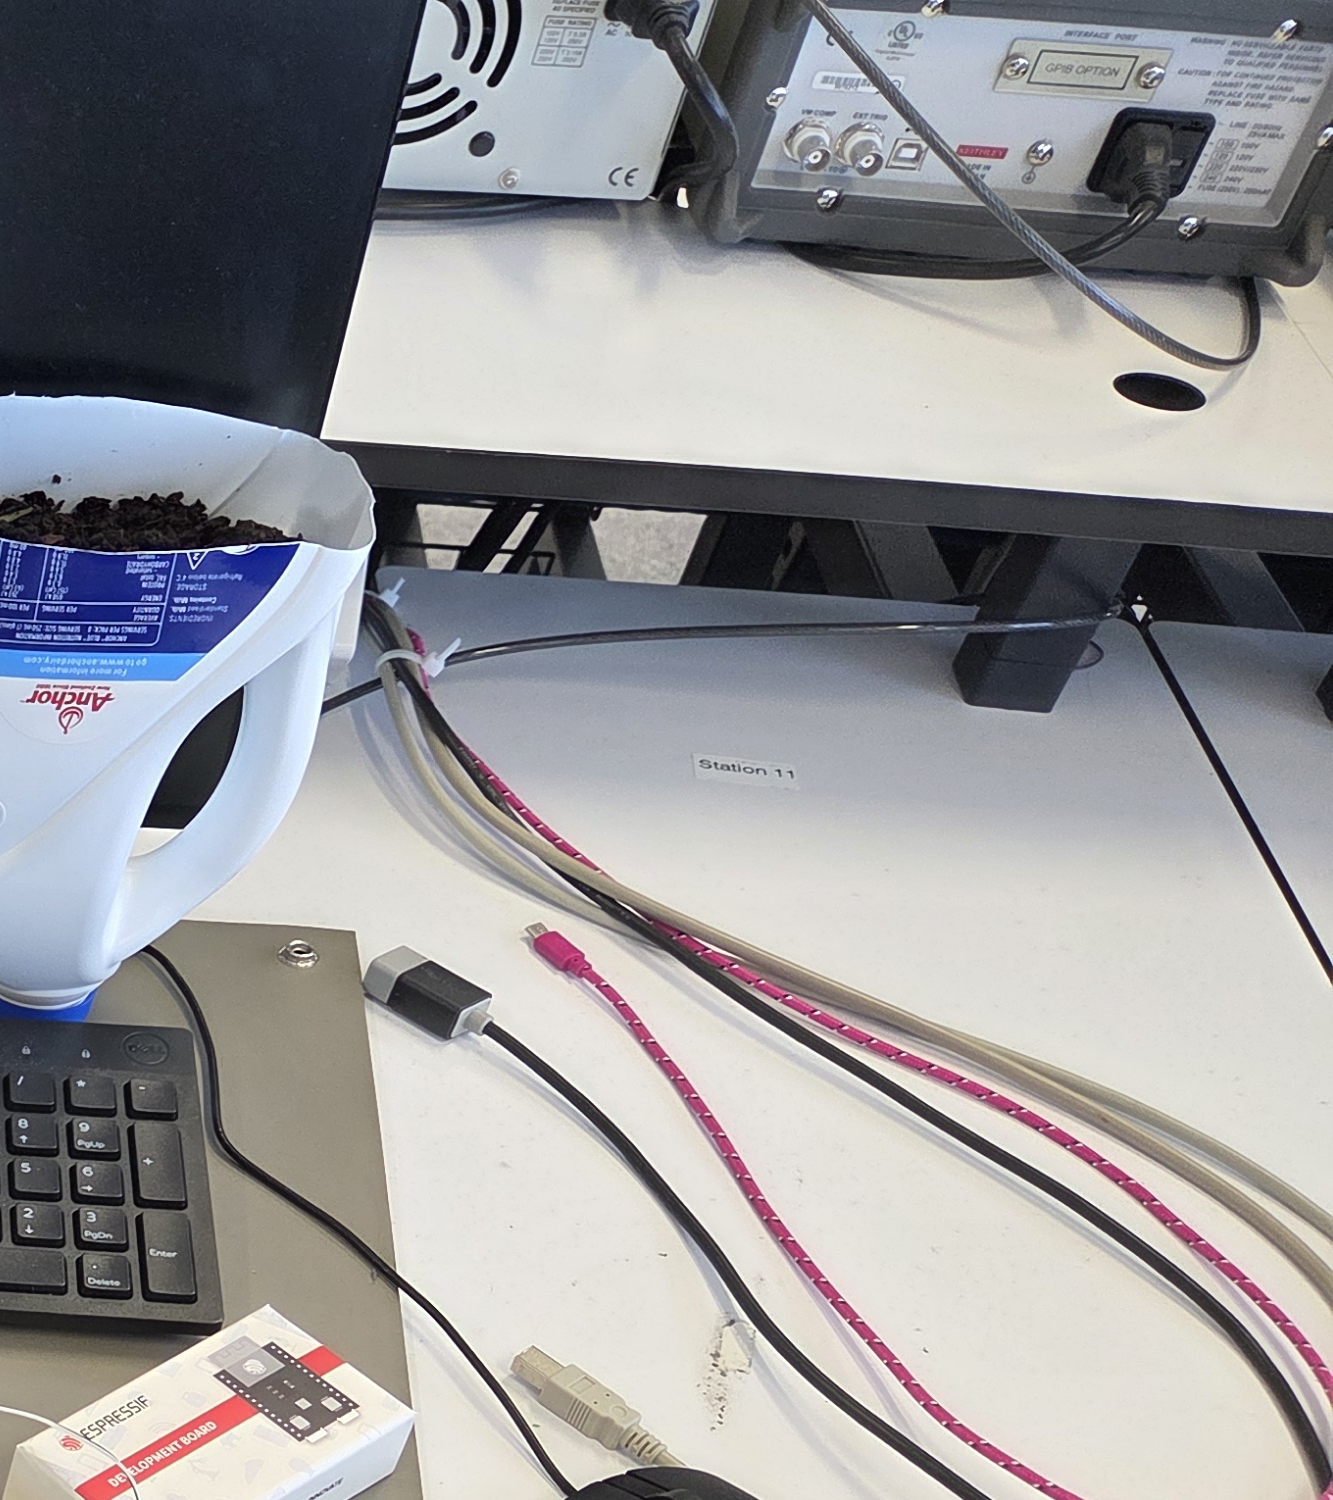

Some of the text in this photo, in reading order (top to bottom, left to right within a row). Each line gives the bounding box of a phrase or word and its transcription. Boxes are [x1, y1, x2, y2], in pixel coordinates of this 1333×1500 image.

[1075, 65, 1120, 77] OPTION
[23, 656, 147, 666] go to www.anchordairy.com
[40, 666, 88, 676] information
[111, 668, 127, 676] For
[26, 688, 115, 712] Anchor
[699, 759, 795, 780] Station 11
[149, 1249, 177, 1259] Enter
[80, 1395, 148, 1440] ESPRESSIF
[180, 1421, 217, 1445] BOARD
